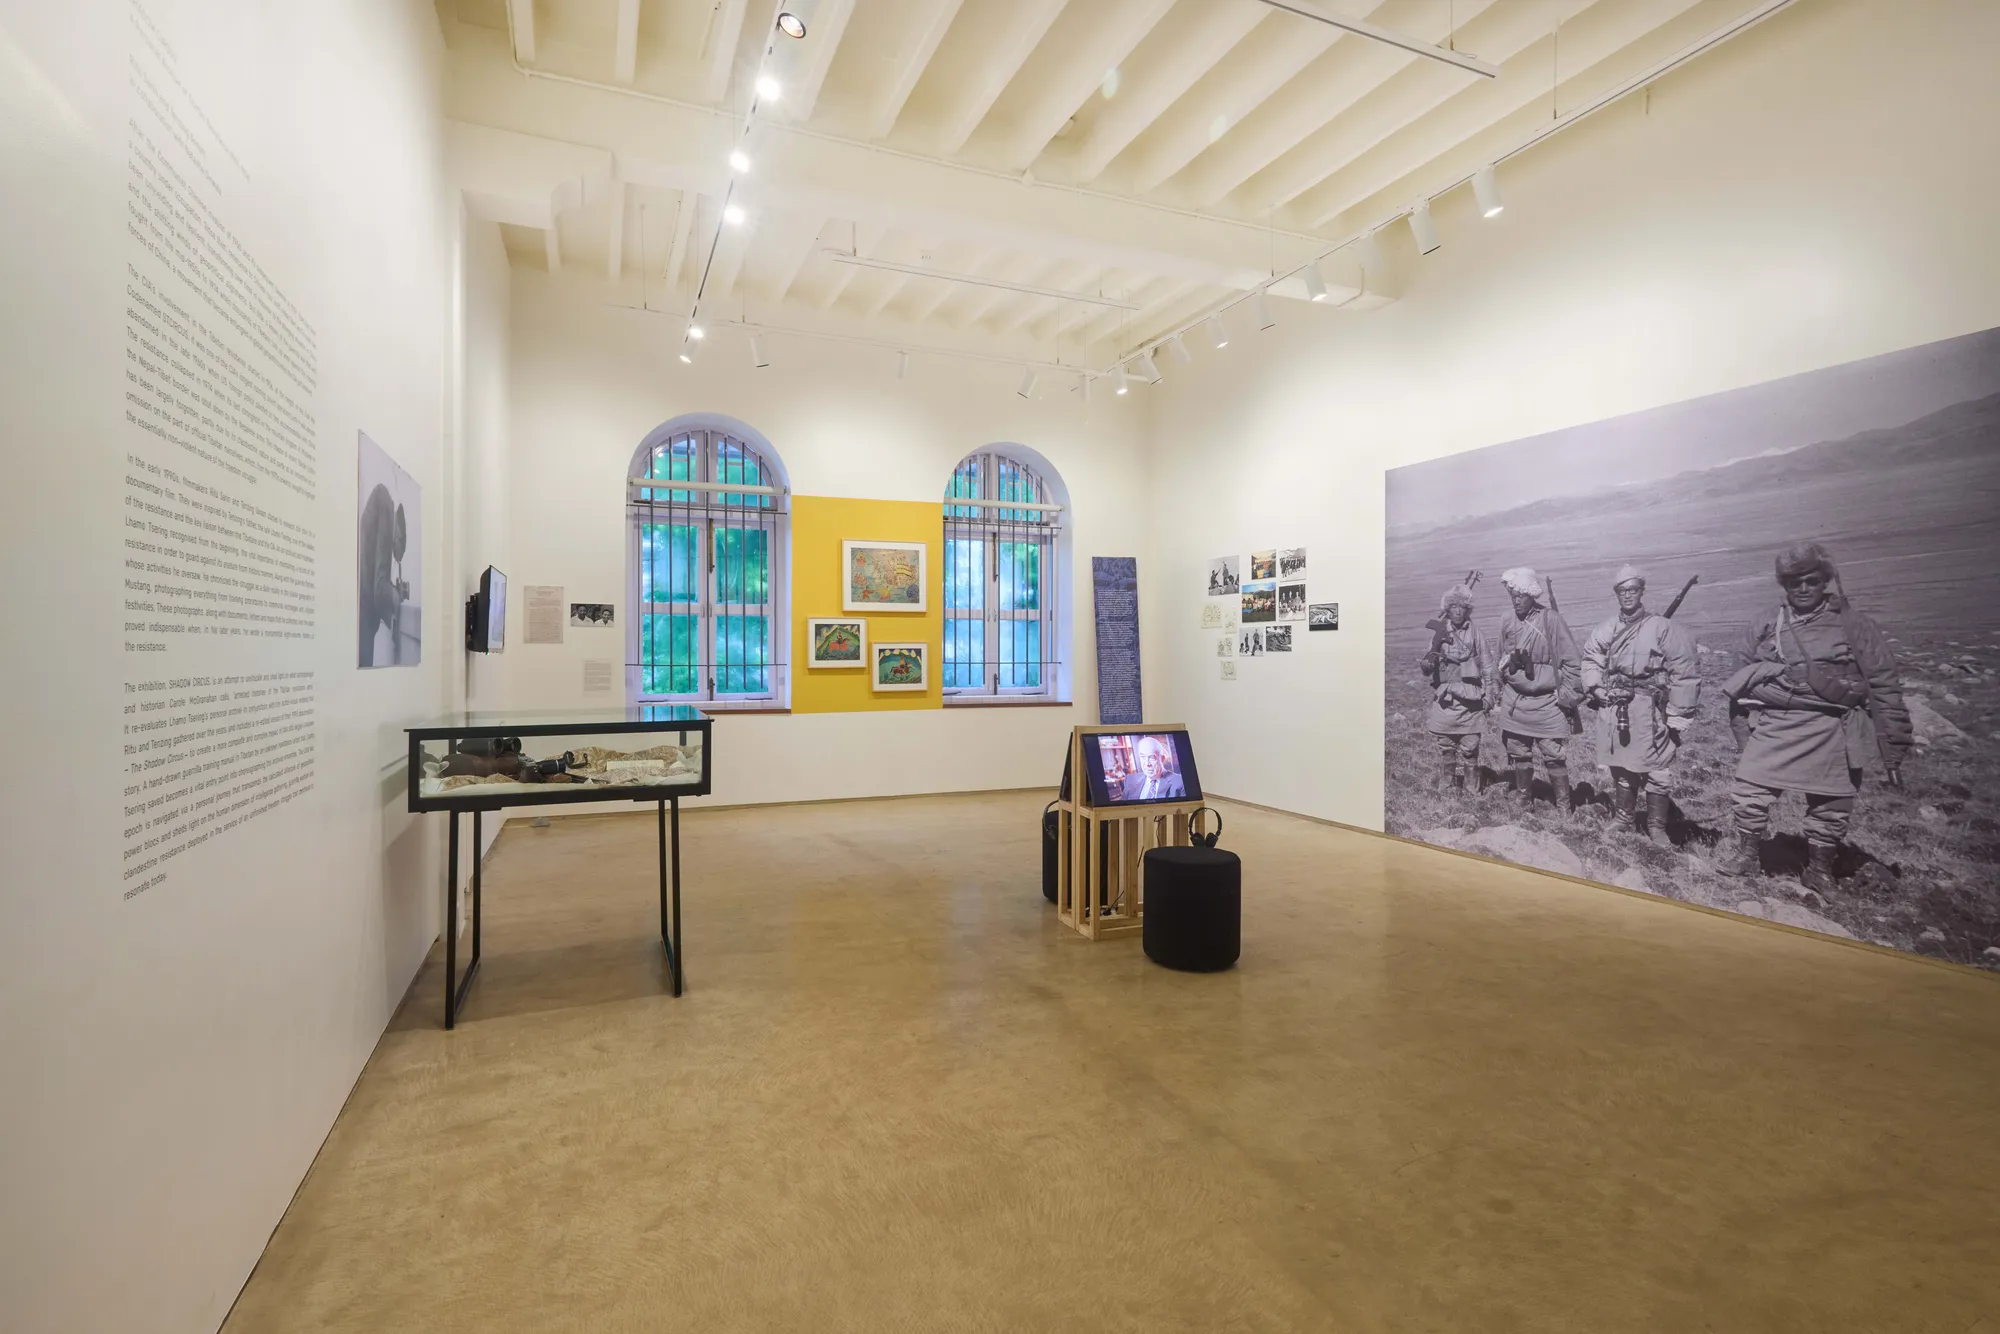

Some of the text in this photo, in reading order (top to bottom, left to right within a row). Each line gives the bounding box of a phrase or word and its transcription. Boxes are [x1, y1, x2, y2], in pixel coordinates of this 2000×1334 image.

[148, 464, 161, 477] early
[126, 475, 164, 497] documentary
[179, 493, 190, 506] They
[145, 503, 173, 519] resistance
[174, 513, 184, 522] and
[125, 516, 145, 531] Lhamo
[148, 522, 168, 539] Tsering
[170, 530, 197, 544] recognised
[125, 539, 156, 553] resistance
[164, 548, 178, 557] order
[186, 553, 199, 563] guard
[125, 558, 145, 570] whose
[147, 564, 172, 575] activities
[155, 584, 192, 599] photographing
[157, 602, 173, 614] These
[125, 622, 145, 632] proved
[149, 622, 185, 634] indispensable
[137, 643, 168, 652] resistance.
[124, 683, 136, 693] The
[169, 679, 191, 690] SHADOW
[124, 704, 136, 715] and
[141, 701, 165, 712] historian
[170, 698, 186, 708] Carole
[132, 720, 167, 733] re-evaluates
[169, 717, 187, 727] Lhamo
[139, 741, 149, 753] and
[151, 738, 172, 749] Tenzing
[173, 732, 195, 747] gathered
[131, 763, 142, 774] The
[144, 758, 166, 771] Shadow
[168, 753, 184, 764] Circus
[149, 772, 181, 788] hand-drawn
[124, 803, 146, 817] Tsering
[148, 795, 164, 809] saved
[166, 788, 188, 803] becomes
[124, 823, 143, 839] epoch
[153, 808, 179, 826] navigated
[124, 845, 143, 861] power
[145, 837, 159, 850] blocs
[161, 831, 171, 843] and
[173, 824, 187, 837] sheds
[189, 819, 200, 832] light
[124, 858, 158, 881] clandestine
[160, 844, 186, 862] resistance
[188, 833, 208, 849] deployed
[124, 881, 150, 901] resonate
